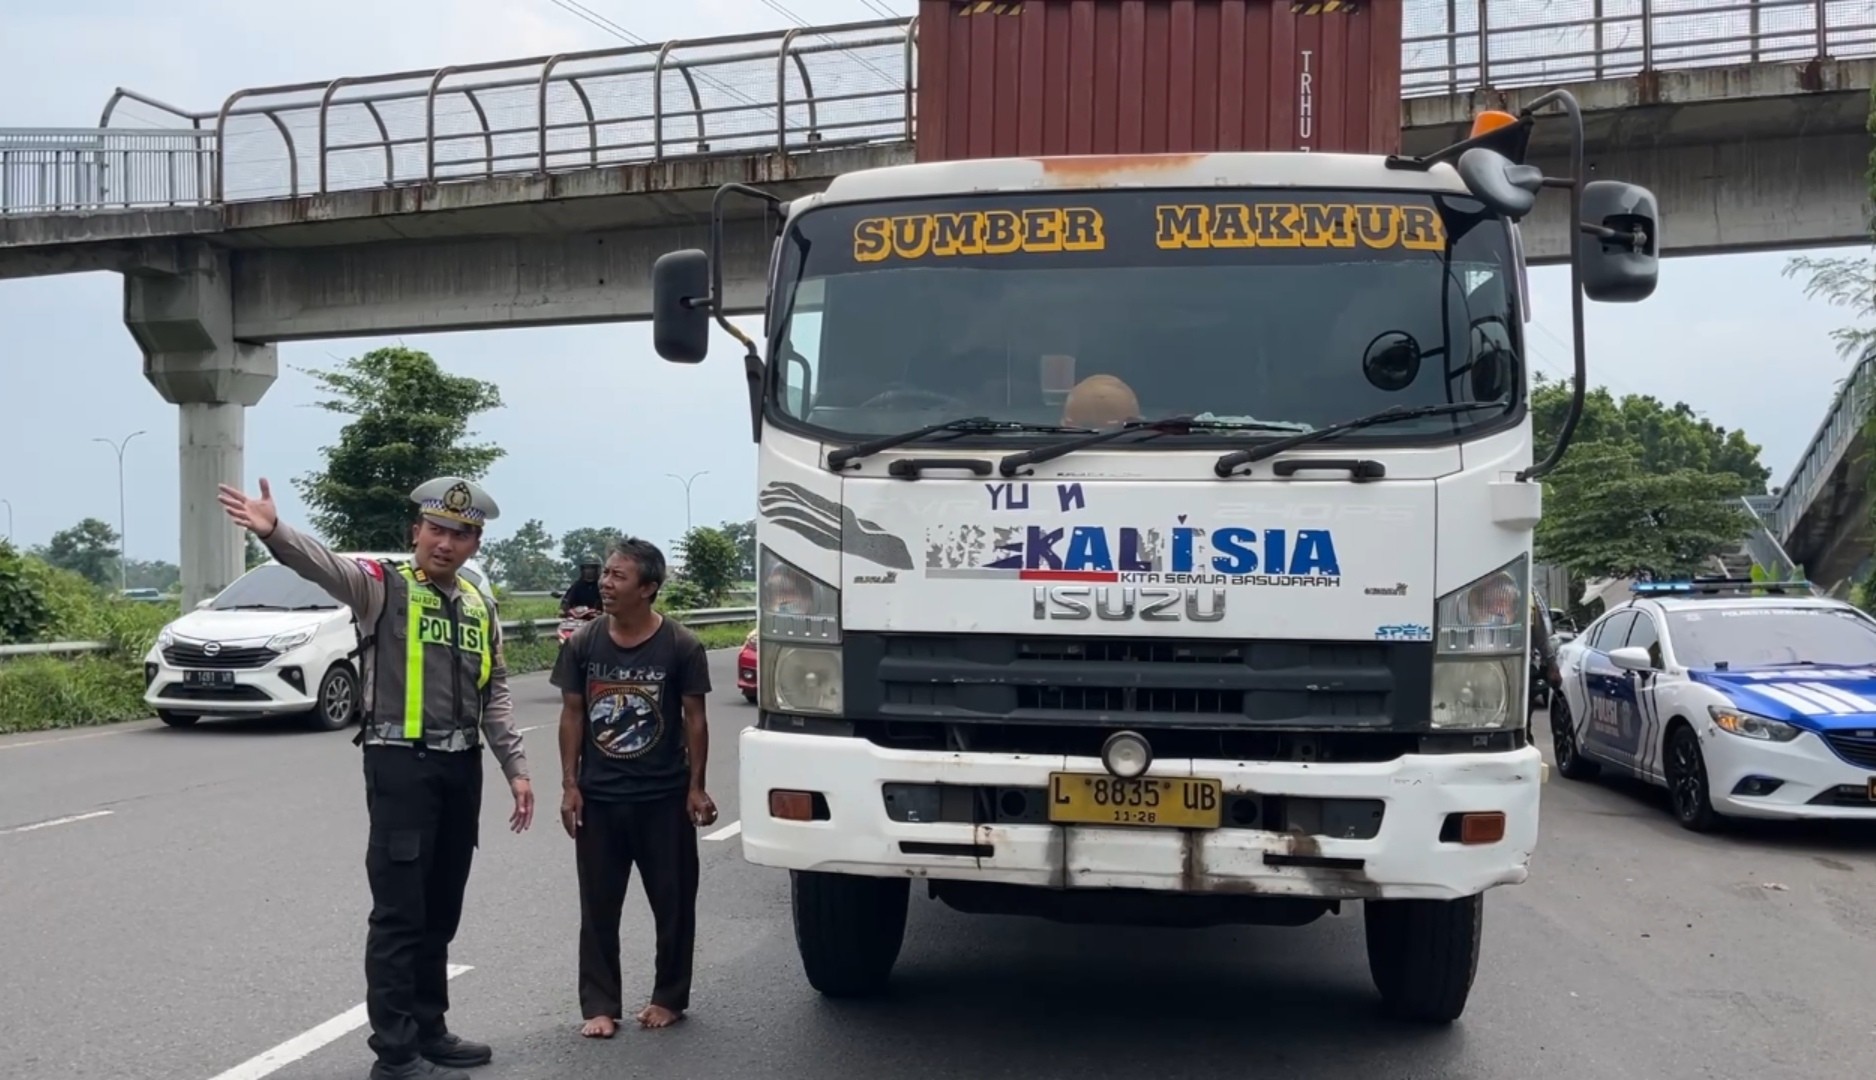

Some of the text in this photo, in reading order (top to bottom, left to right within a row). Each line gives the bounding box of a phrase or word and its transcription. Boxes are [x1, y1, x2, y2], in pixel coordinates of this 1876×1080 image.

[1300, 50, 1313, 139] TRHU
[854, 204, 1446, 262] SUMBER MAKMUR
[1120, 572, 1340, 587] KITA SEMUA BASUDARAH
[1033, 586, 1226, 622] ISUZU
[419, 617, 484, 651] POLISI
[1055, 777, 1216, 810] L 8835 UB
